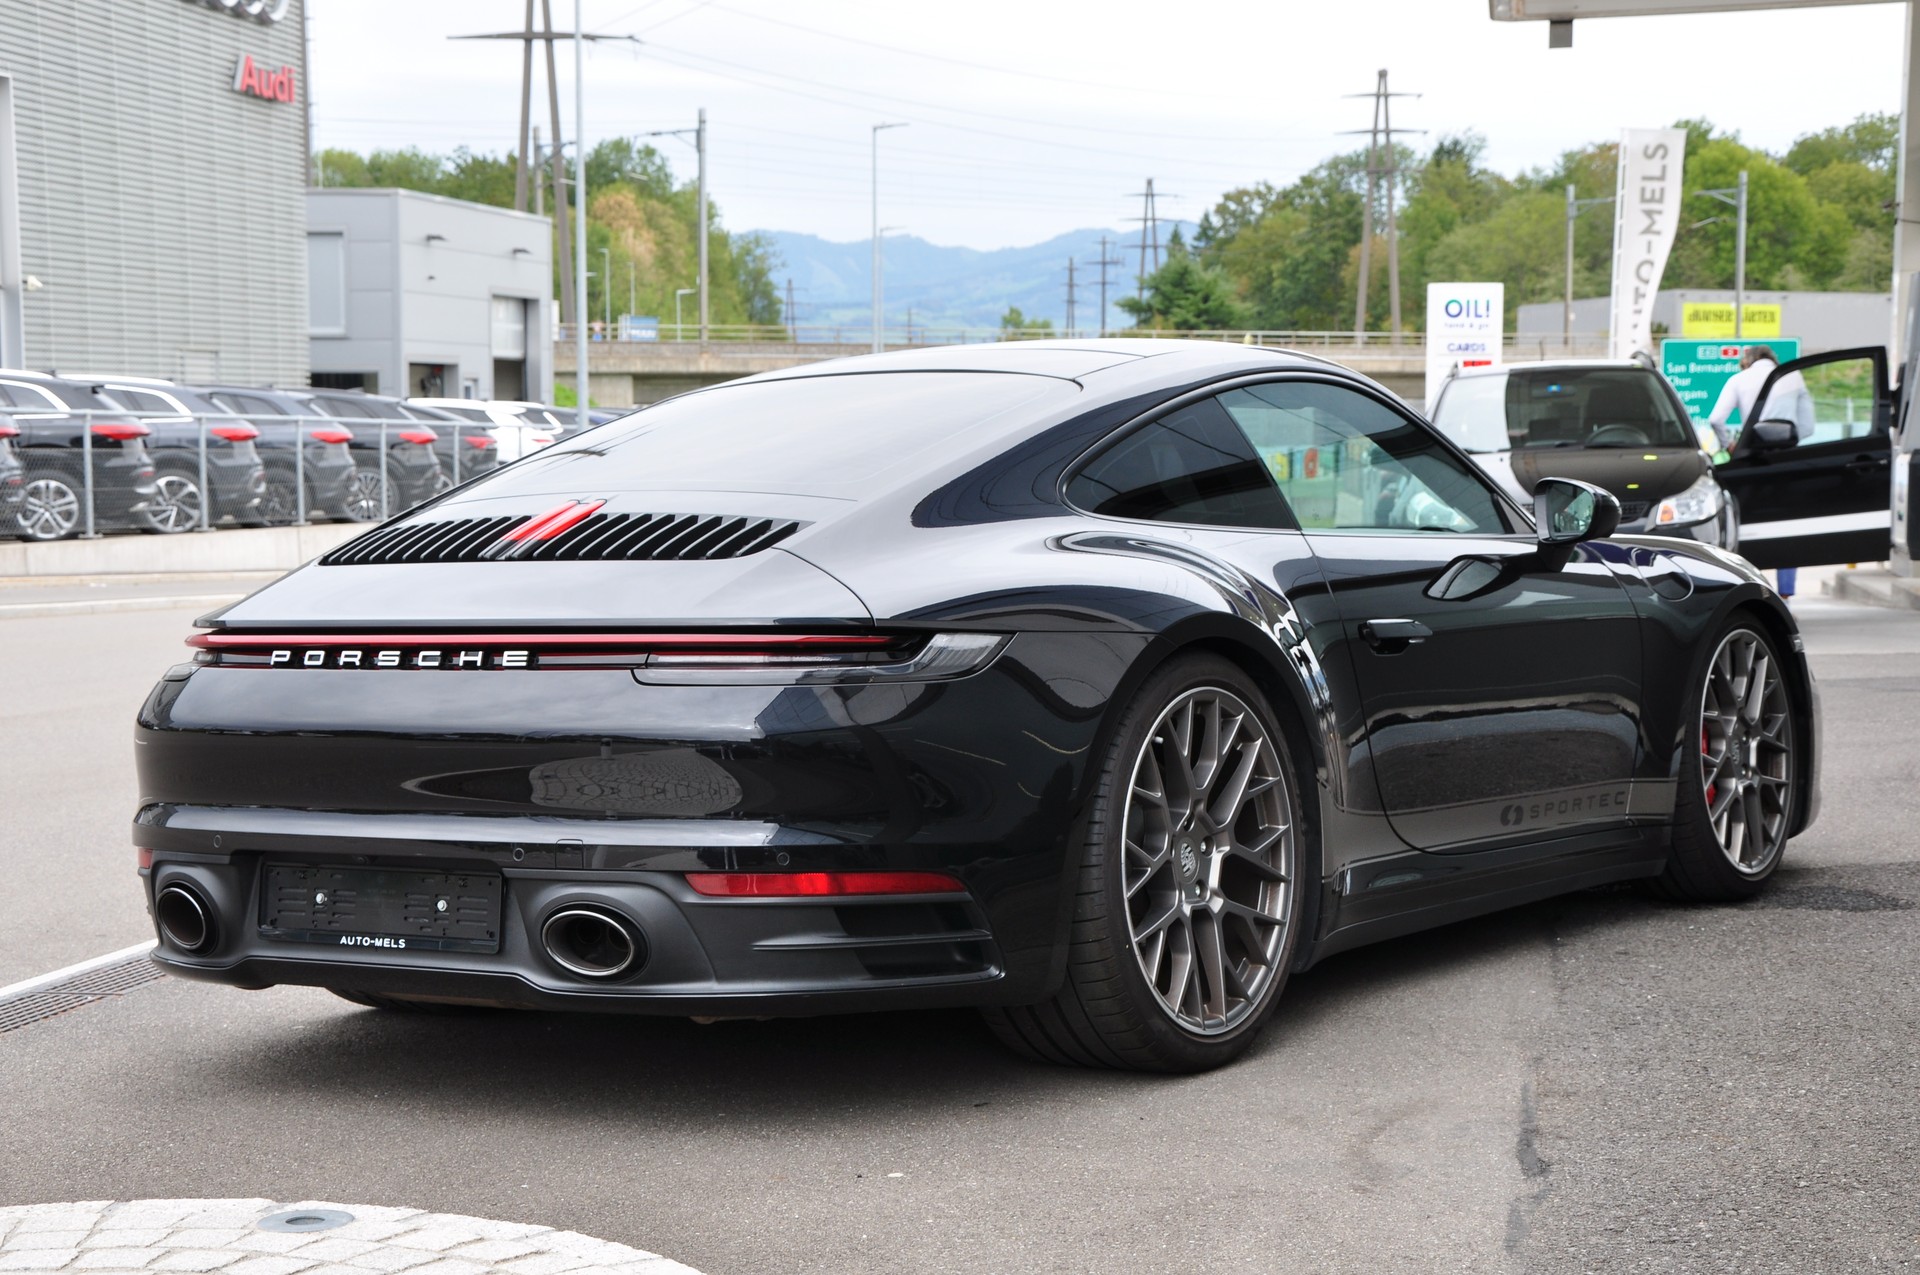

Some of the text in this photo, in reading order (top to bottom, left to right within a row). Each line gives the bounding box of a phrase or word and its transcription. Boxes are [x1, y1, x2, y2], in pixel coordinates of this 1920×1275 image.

[238, 53, 296, 104] Audi
[1445, 299, 1490, 318] OIL!
[1447, 343, 1486, 352] CARDS
[1667, 362, 1741, 373] San Bernardin
[1669, 375, 1692, 387] Chur
[270, 650, 529, 667] PORSCHE
[1530, 791, 1627, 819] SPORTEC
[340, 935, 406, 949] AUTO-MELS
